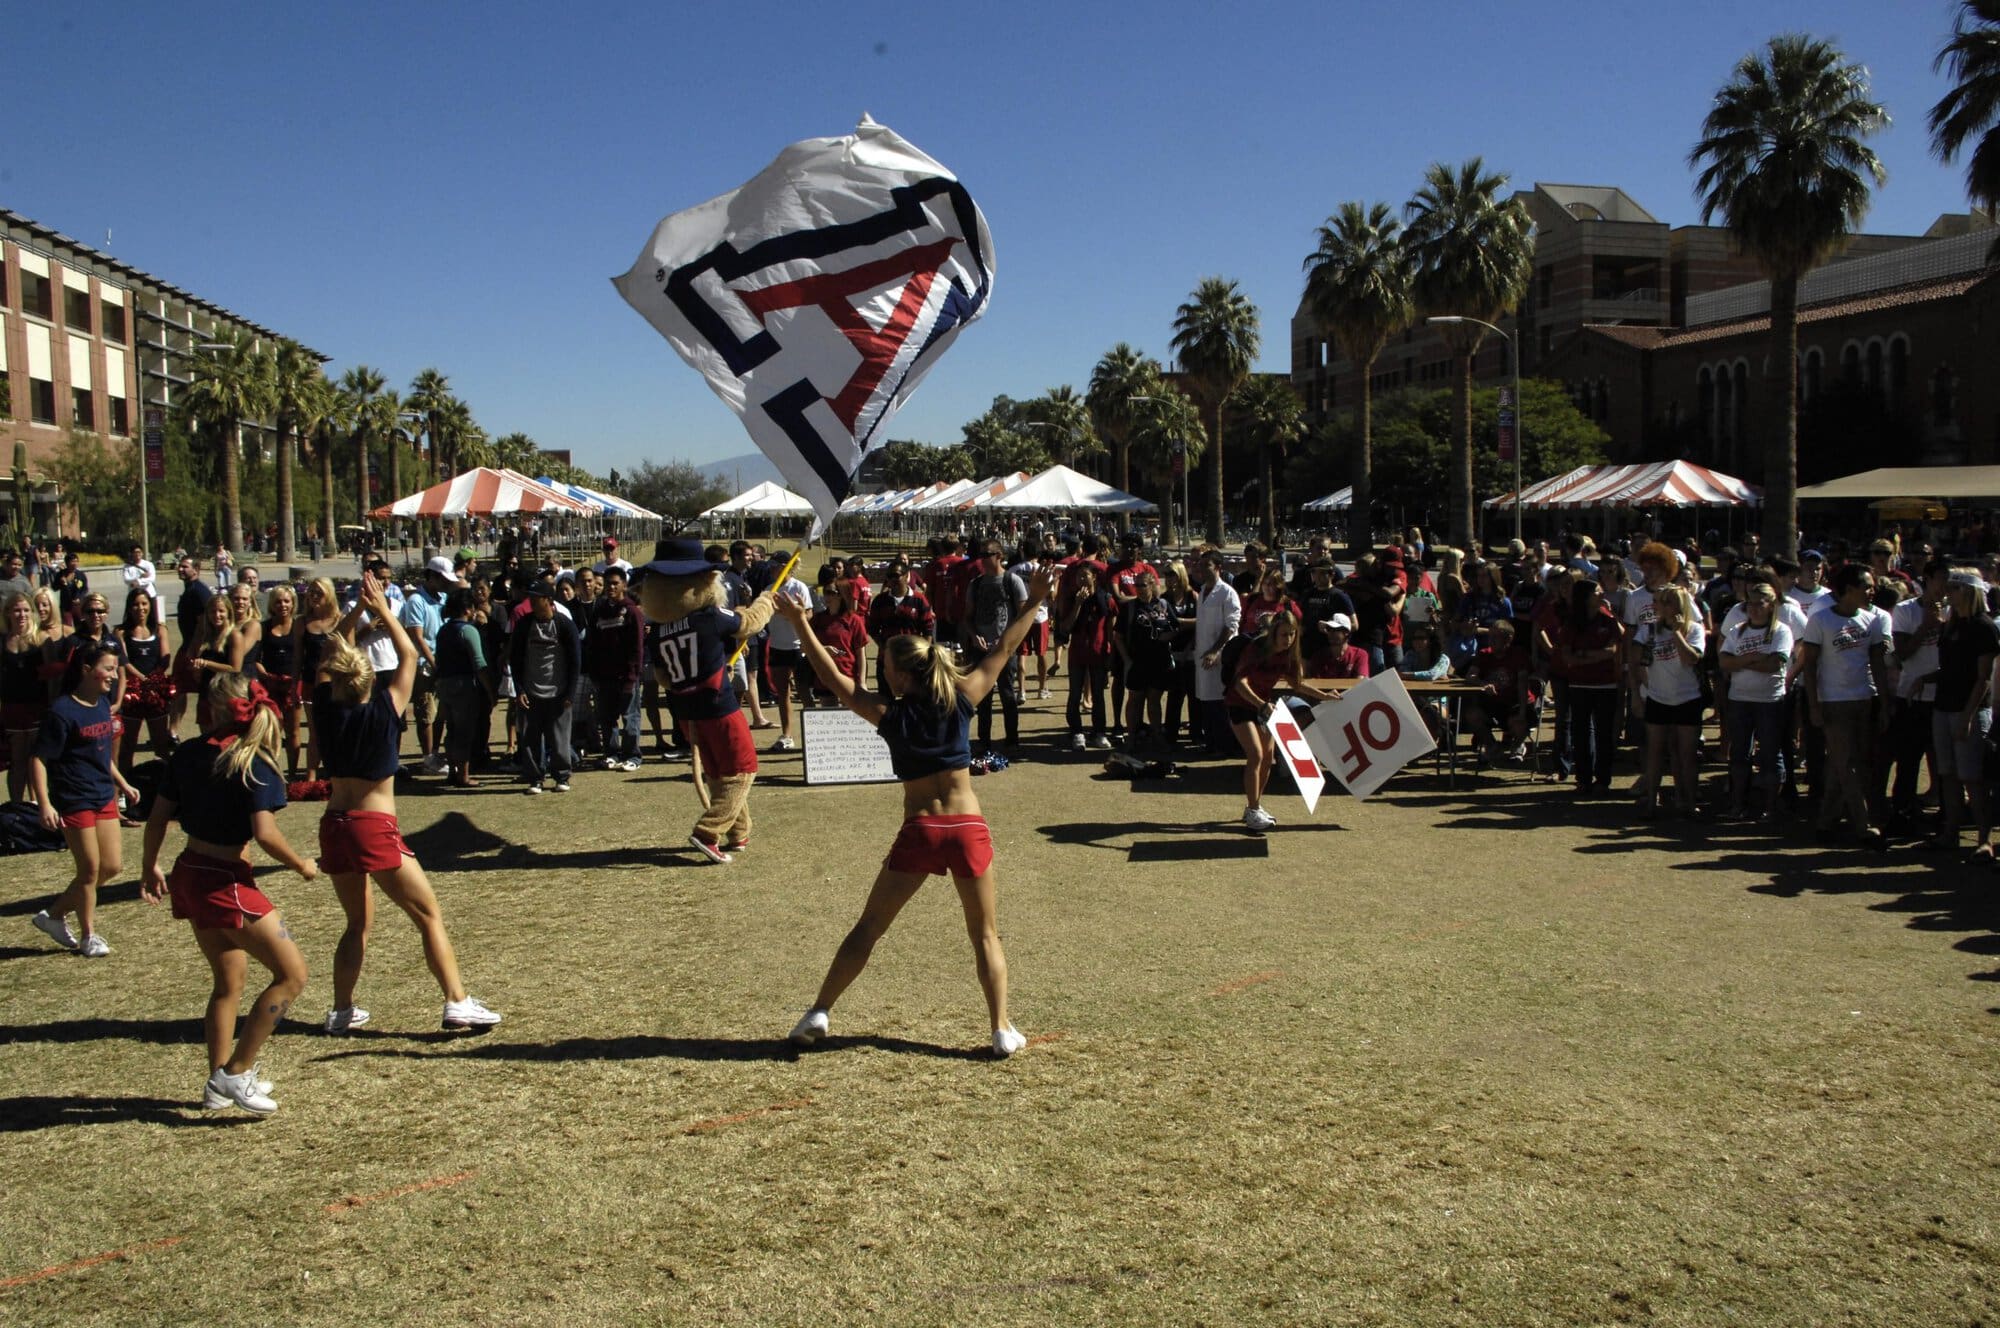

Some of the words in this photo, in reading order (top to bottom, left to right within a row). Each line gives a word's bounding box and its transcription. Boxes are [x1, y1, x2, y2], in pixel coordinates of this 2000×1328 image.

[659, 616, 690, 638] WILBUR
[659, 631, 698, 684] 07
[80, 720, 112, 738] RIZO
[1341, 700, 1401, 785] OF
